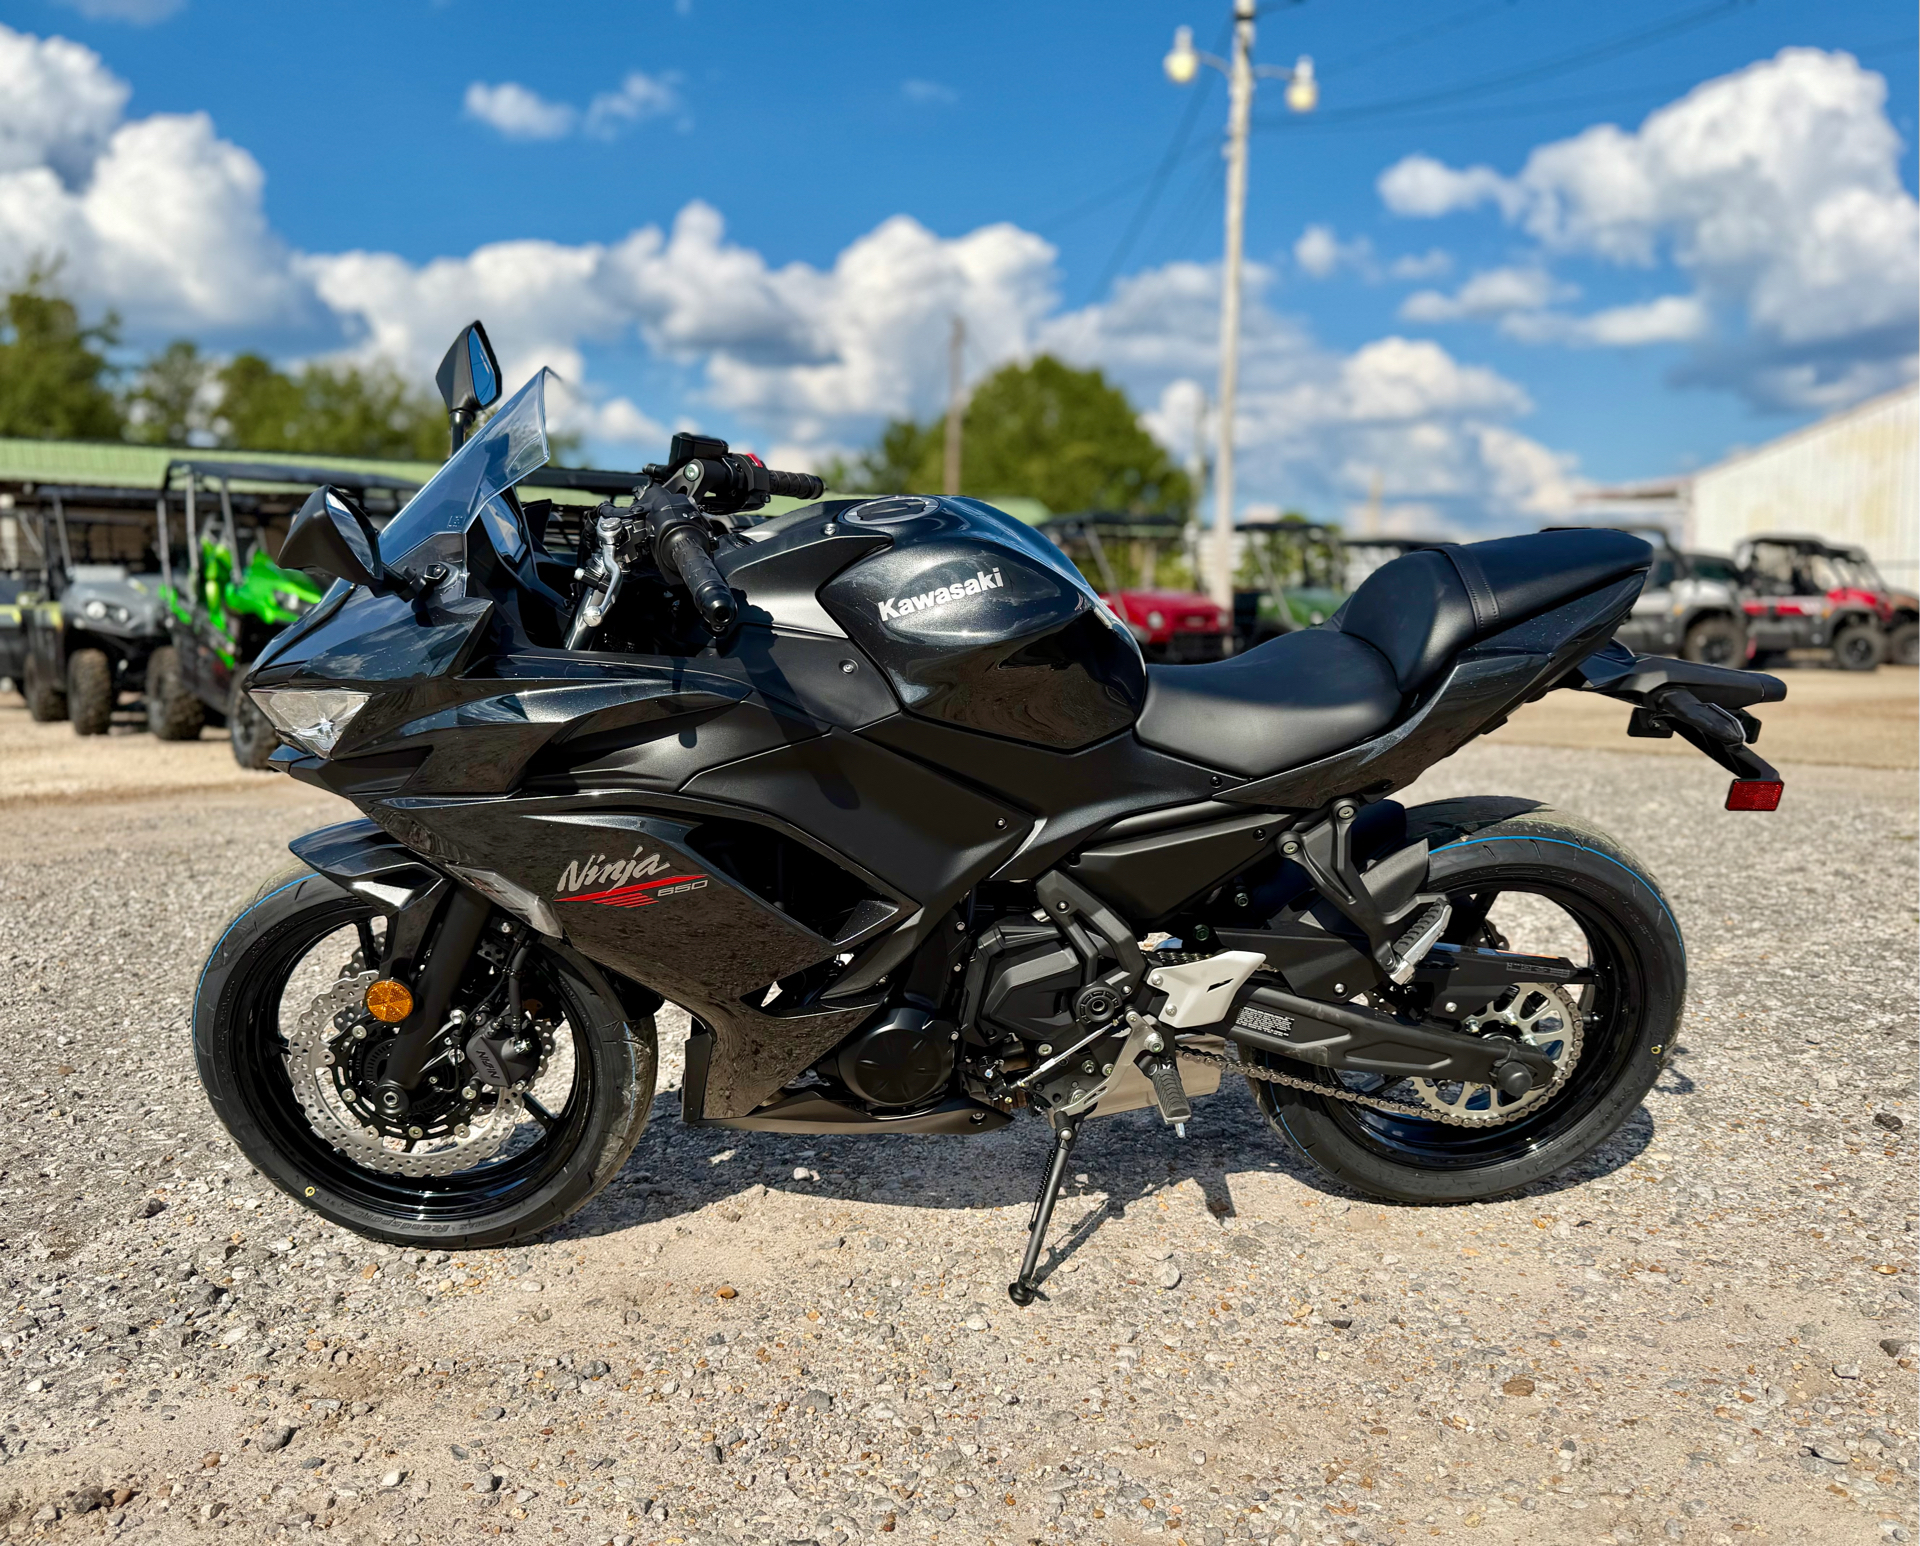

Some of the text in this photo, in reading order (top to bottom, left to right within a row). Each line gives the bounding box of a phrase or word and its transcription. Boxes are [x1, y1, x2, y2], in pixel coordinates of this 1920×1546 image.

[877, 567, 1004, 622] Kawasaki
[556, 845, 671, 895] Ninja
[657, 879, 709, 897] 650
